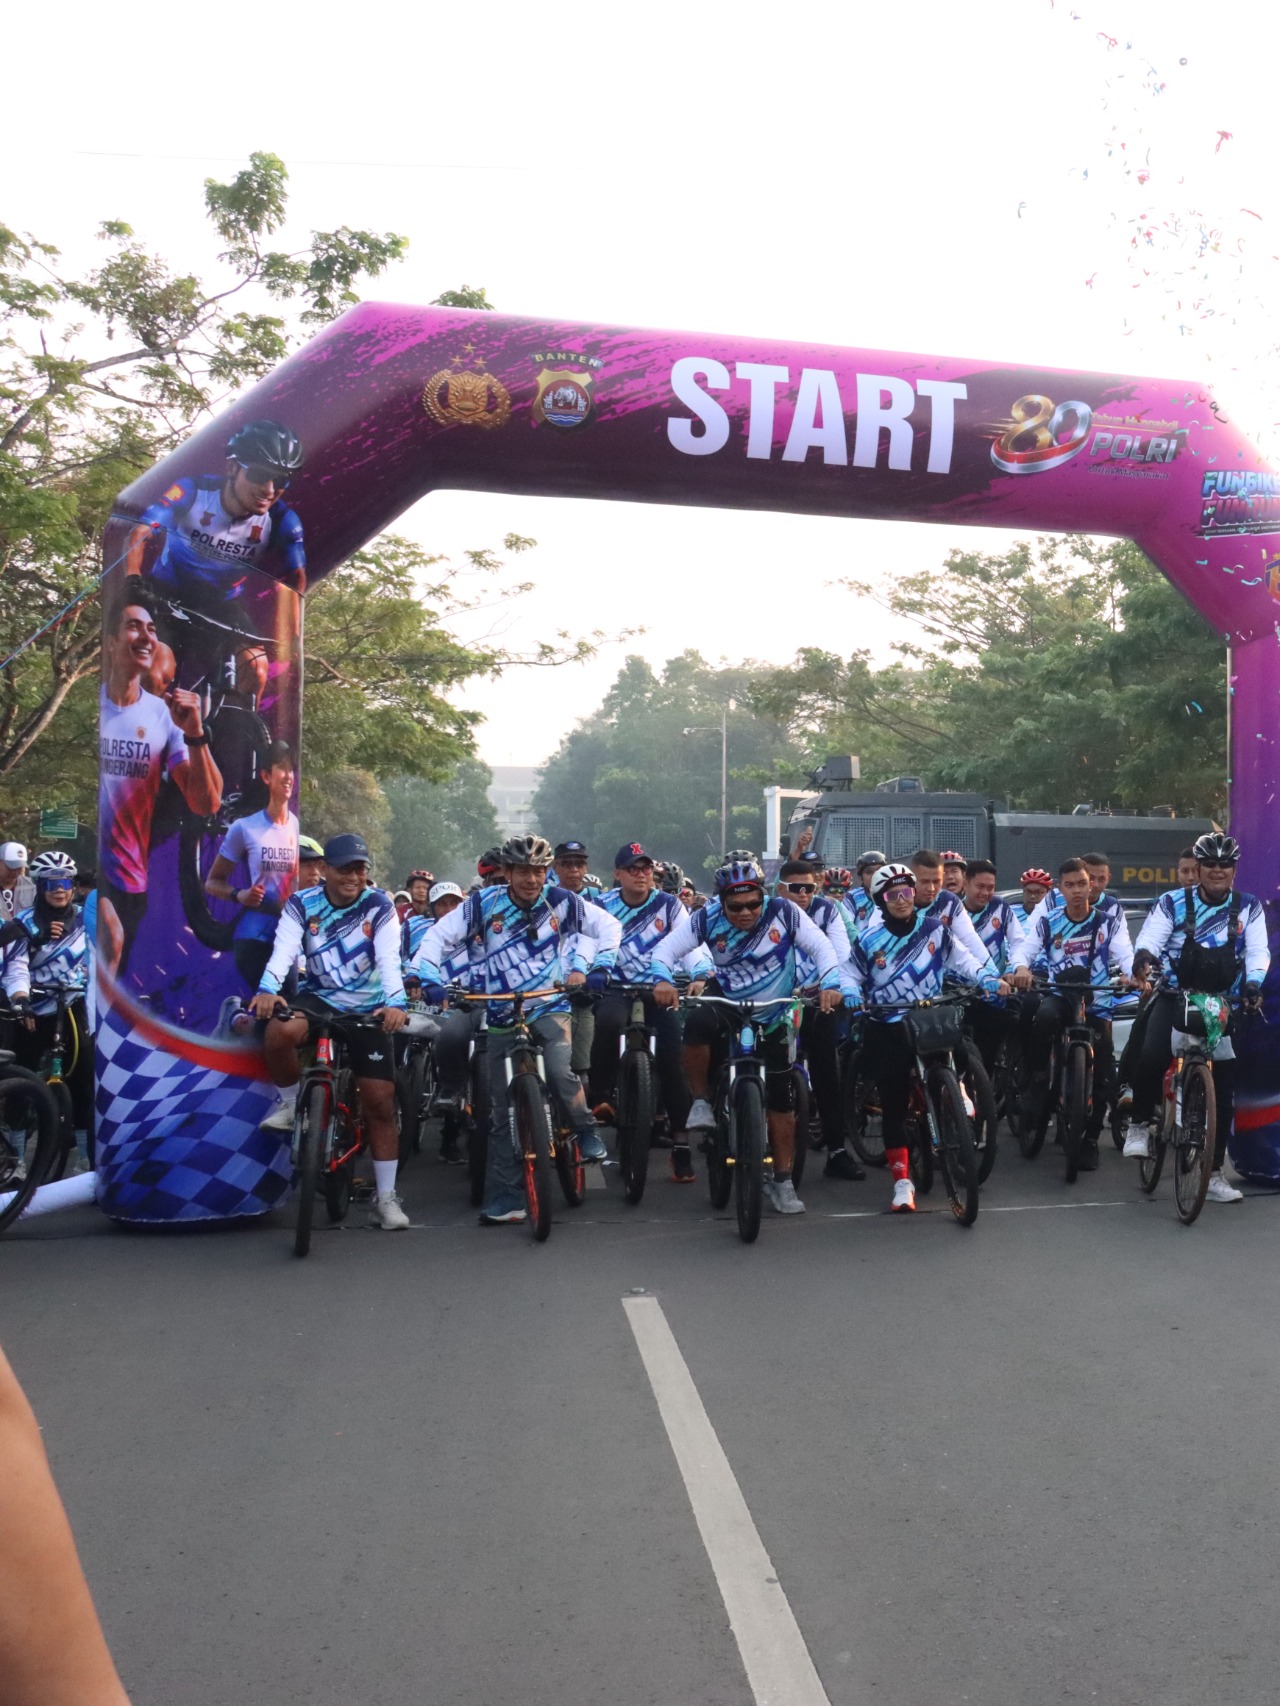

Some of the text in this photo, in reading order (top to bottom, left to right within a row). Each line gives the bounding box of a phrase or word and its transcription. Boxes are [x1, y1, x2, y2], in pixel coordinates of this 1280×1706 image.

[535, 353, 598, 367] BANTEN
[667, 356, 967, 474] START
[1090, 432, 1178, 464] POLRI
[191, 529, 257, 557] POLRESTA
[1123, 867, 1177, 883] POLI
